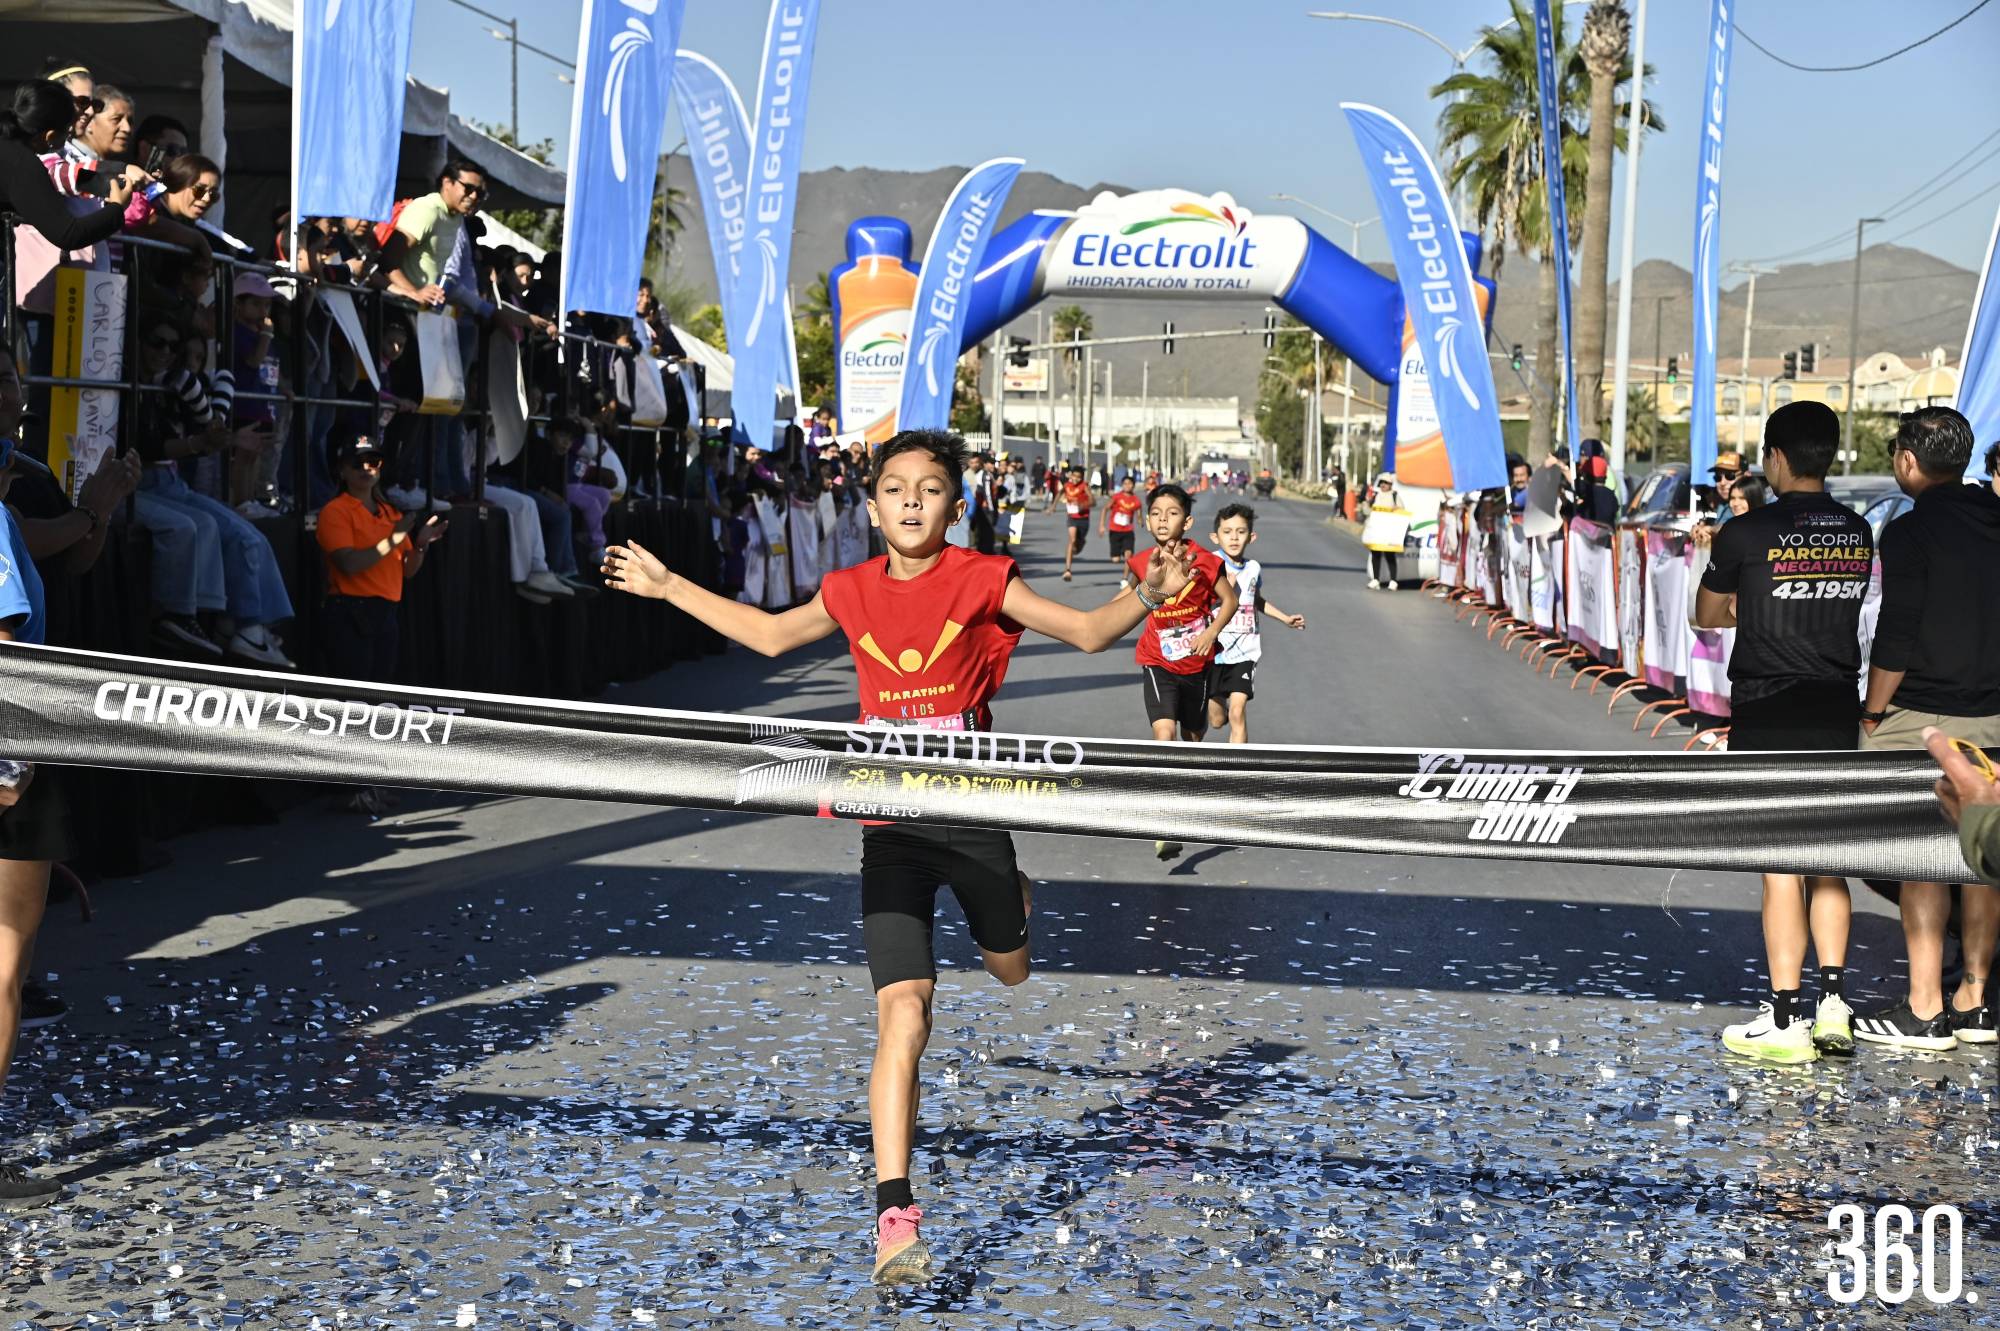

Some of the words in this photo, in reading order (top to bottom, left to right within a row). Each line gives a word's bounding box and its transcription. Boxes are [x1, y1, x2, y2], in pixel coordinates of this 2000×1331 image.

[1383, 149, 1458, 313] Electrolit
[930, 192, 994, 322] Electrolit
[1072, 234, 1257, 268] Electrolit
[1066, 275, 1187, 290] ¡HIDRATACIÓN
[1193, 278, 1251, 290] TOTAL!
[1778, 533, 1804, 546] YO
[1809, 531, 1863, 546] CORRÍ
[1767, 547, 1870, 561] PARCIALES
[1773, 561, 1868, 573] NEGATIVOS
[1772, 581, 1867, 600] 42.195K
[879, 683, 955, 703] MARATHON
[901, 703, 935, 717] KIDS
[835, 801, 879, 815] GRAN
[881, 804, 920, 817] RETO
